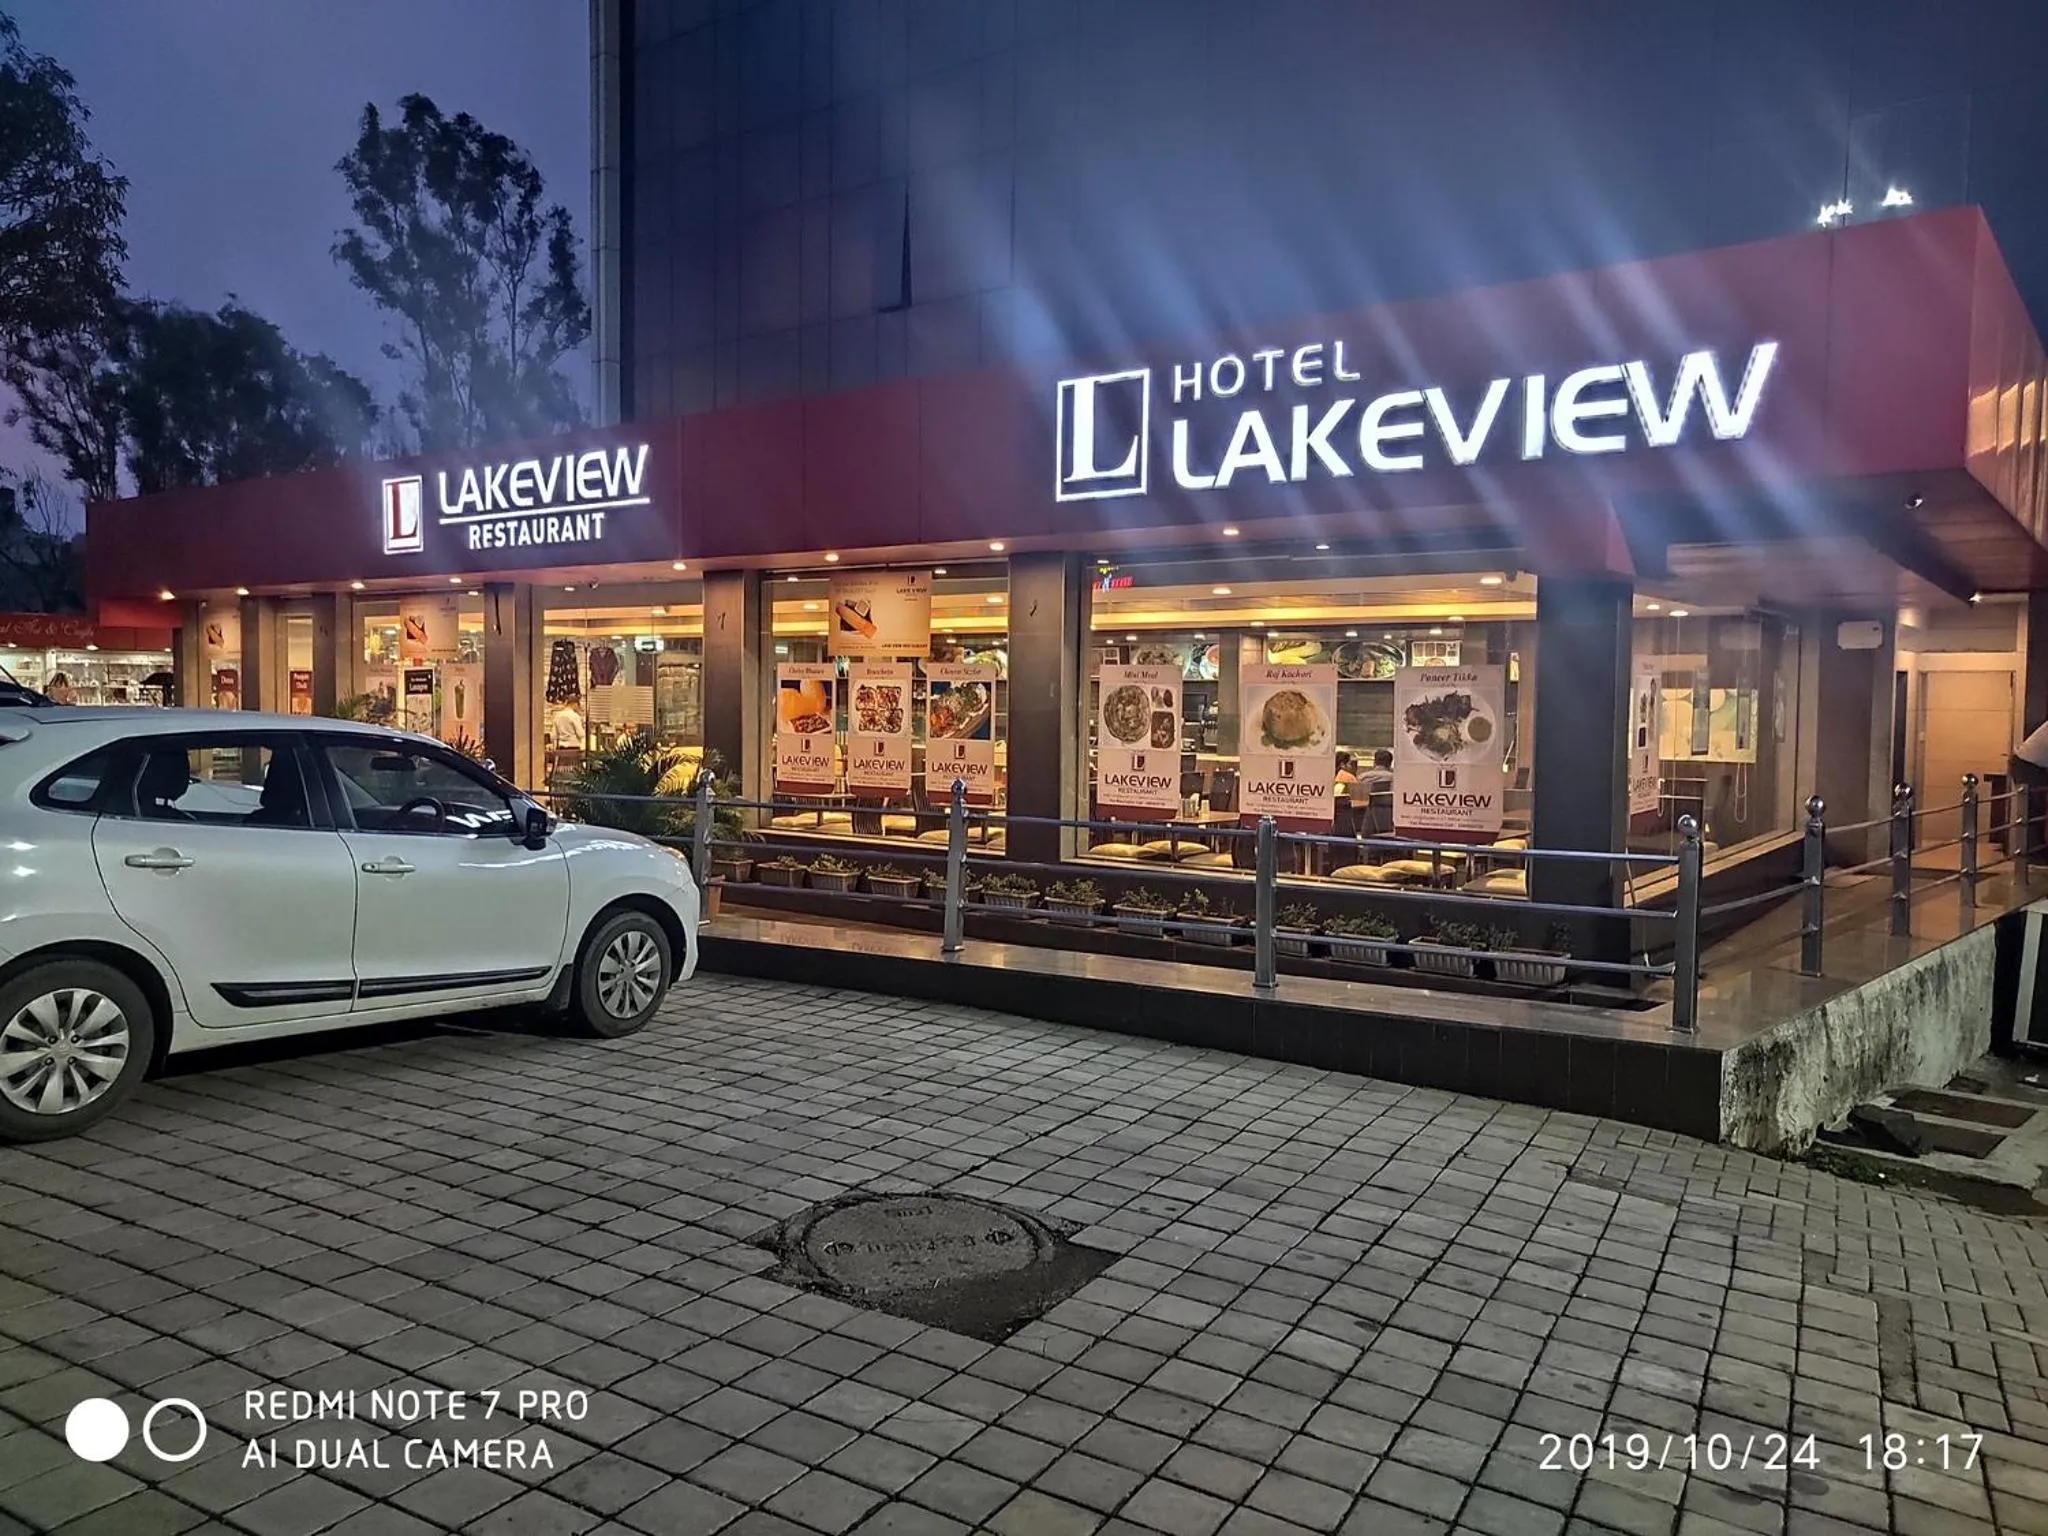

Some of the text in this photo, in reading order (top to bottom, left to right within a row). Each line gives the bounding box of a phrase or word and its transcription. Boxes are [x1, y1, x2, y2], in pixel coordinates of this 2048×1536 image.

[1173, 340, 1361, 403] HOTEL
[1172, 342, 1779, 490] LAKEVIEW
[437, 444, 650, 515] LAKEVIEW
[468, 511, 605, 550] RESTAURANT
[781, 754, 830, 767] LAKEVIEW
[853, 758, 905, 771] LAKEVIEW
[931, 761, 988, 775] LAKEVIEW
[1104, 773, 1172, 788] LAKEVIEW
[1247, 780, 1325, 797] LAKEVIEW
[1262, 795, 1309, 805] RESTAURANT
[1402, 791, 1492, 808] LAKEVIEW
[1420, 807, 1473, 817] RESTAURANT
